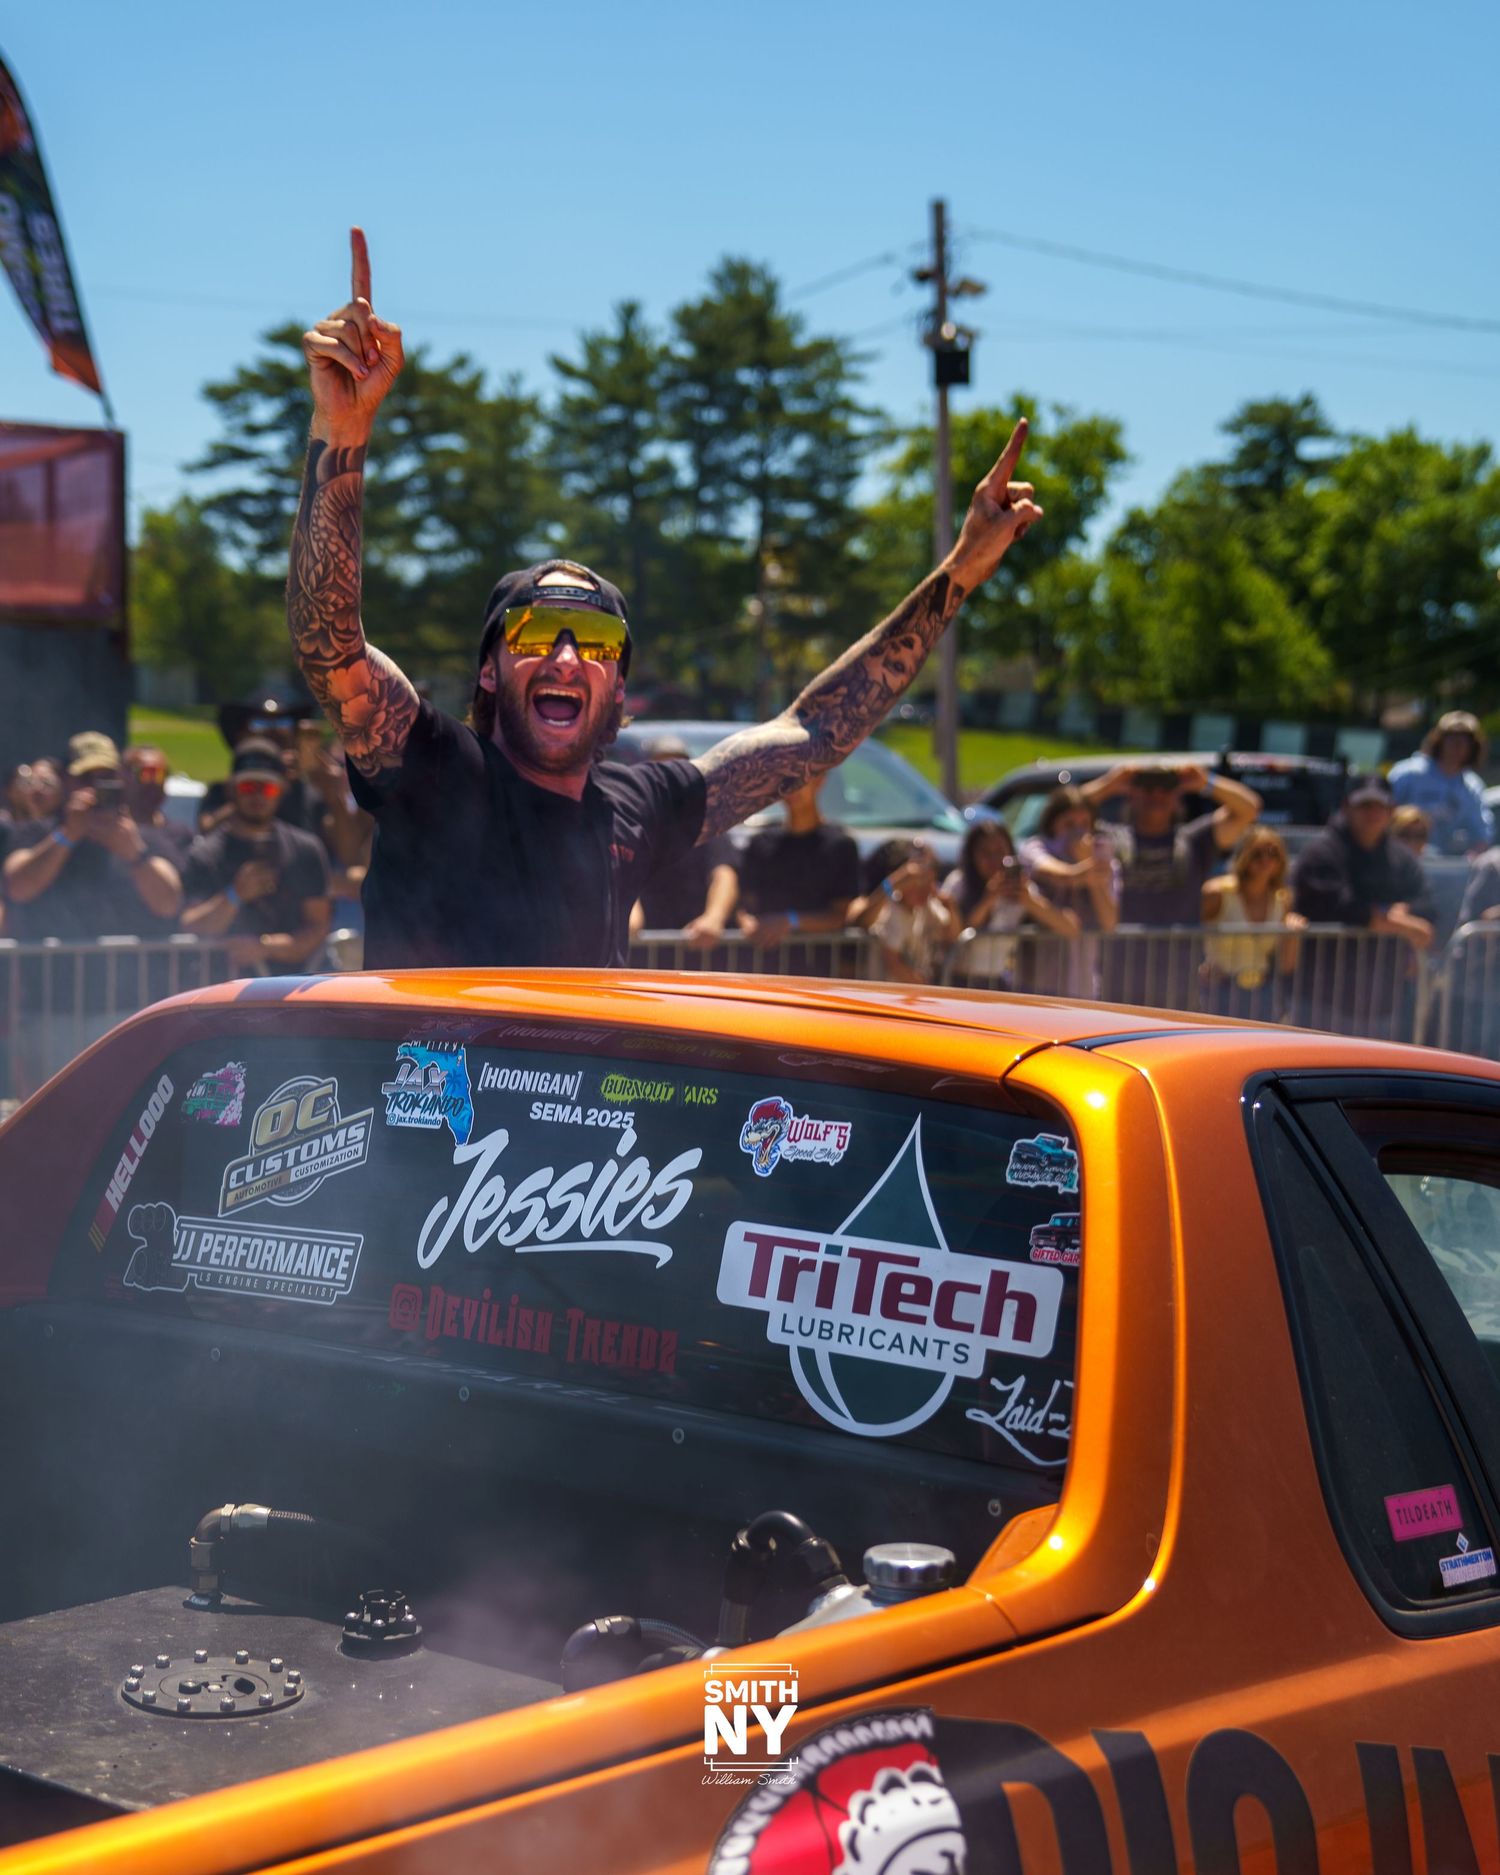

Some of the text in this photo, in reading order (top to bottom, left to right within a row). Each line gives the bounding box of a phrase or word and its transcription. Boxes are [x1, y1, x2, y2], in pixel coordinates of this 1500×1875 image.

[601, 1075, 676, 1102] BURNOUT
[255, 1083, 334, 1146] OC
[529, 1102, 635, 1130] SEMA 2025
[229, 1121, 366, 1189] CUSTOMS
[233, 1147, 360, 1201] AUTOMOTIVE CUSTOMIZATION
[814, 1147, 842, 1163] Shop
[417, 1128, 702, 1269] Jessies
[196, 1231, 354, 1281] PERFORMANCE
[1033, 1248, 1060, 1261] GIFTED
[199, 1273, 335, 1298] LS ENGINE SPECIALIST
[743, 1231, 1038, 1344] TriTech
[781, 1314, 970, 1364] LUBRICANTS
